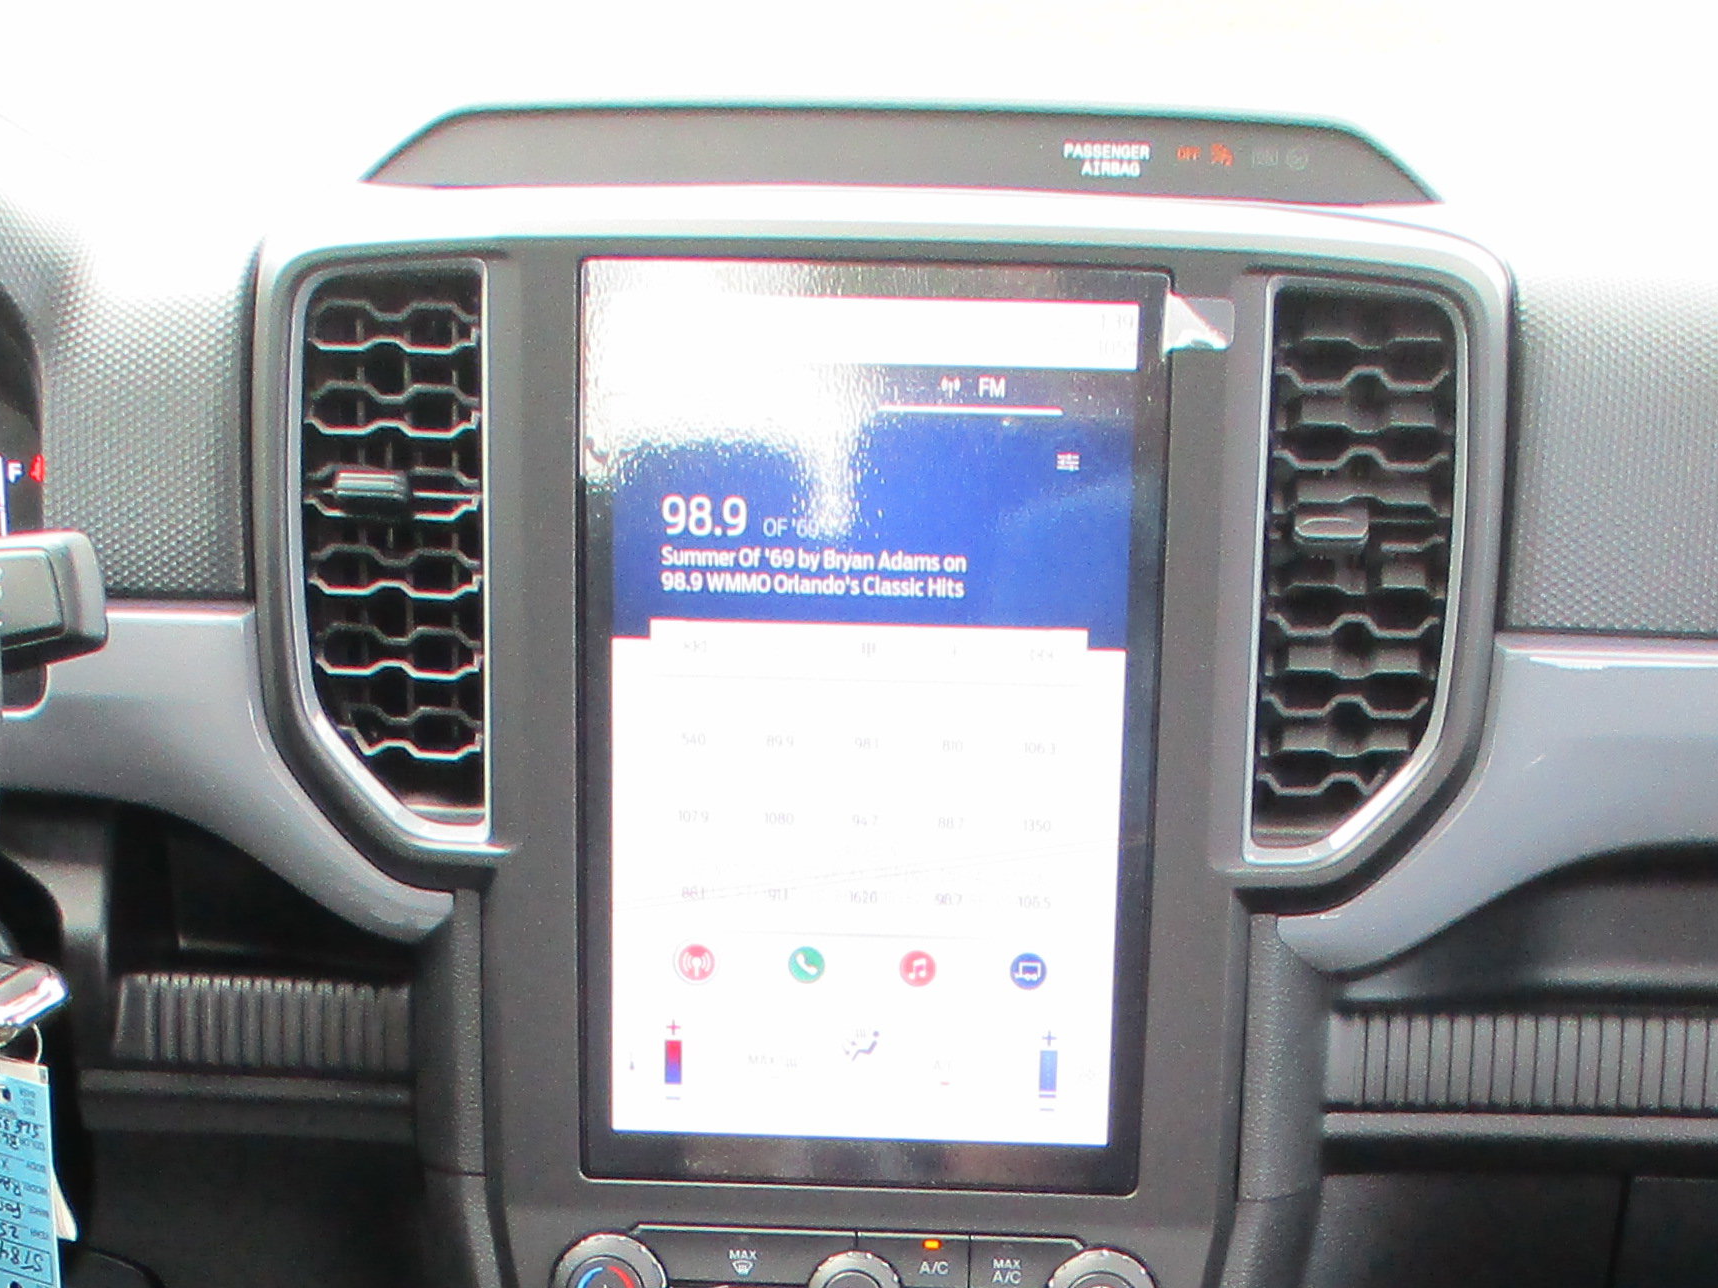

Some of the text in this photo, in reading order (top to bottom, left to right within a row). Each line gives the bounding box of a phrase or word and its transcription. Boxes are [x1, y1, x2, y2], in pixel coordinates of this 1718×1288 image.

[1063, 139, 1150, 161] PASSENGER
[1081, 159, 1141, 177] AIRBAG
[977, 375, 1005, 398] FM
[7, 460, 24, 483] F
[661, 493, 748, 537] 98.9
[763, 518, 789, 537] OF
[660, 544, 968, 573] Summer Of '69 by Bryan Adams on
[660, 570, 965, 598] 98.9 WMMO Orlando's Classic Hits
[729, 1249, 758, 1261] MAX
[992, 1257, 1022, 1270] MAX
[919, 1261, 949, 1276] A/C
[992, 1270, 1022, 1284] A/C
